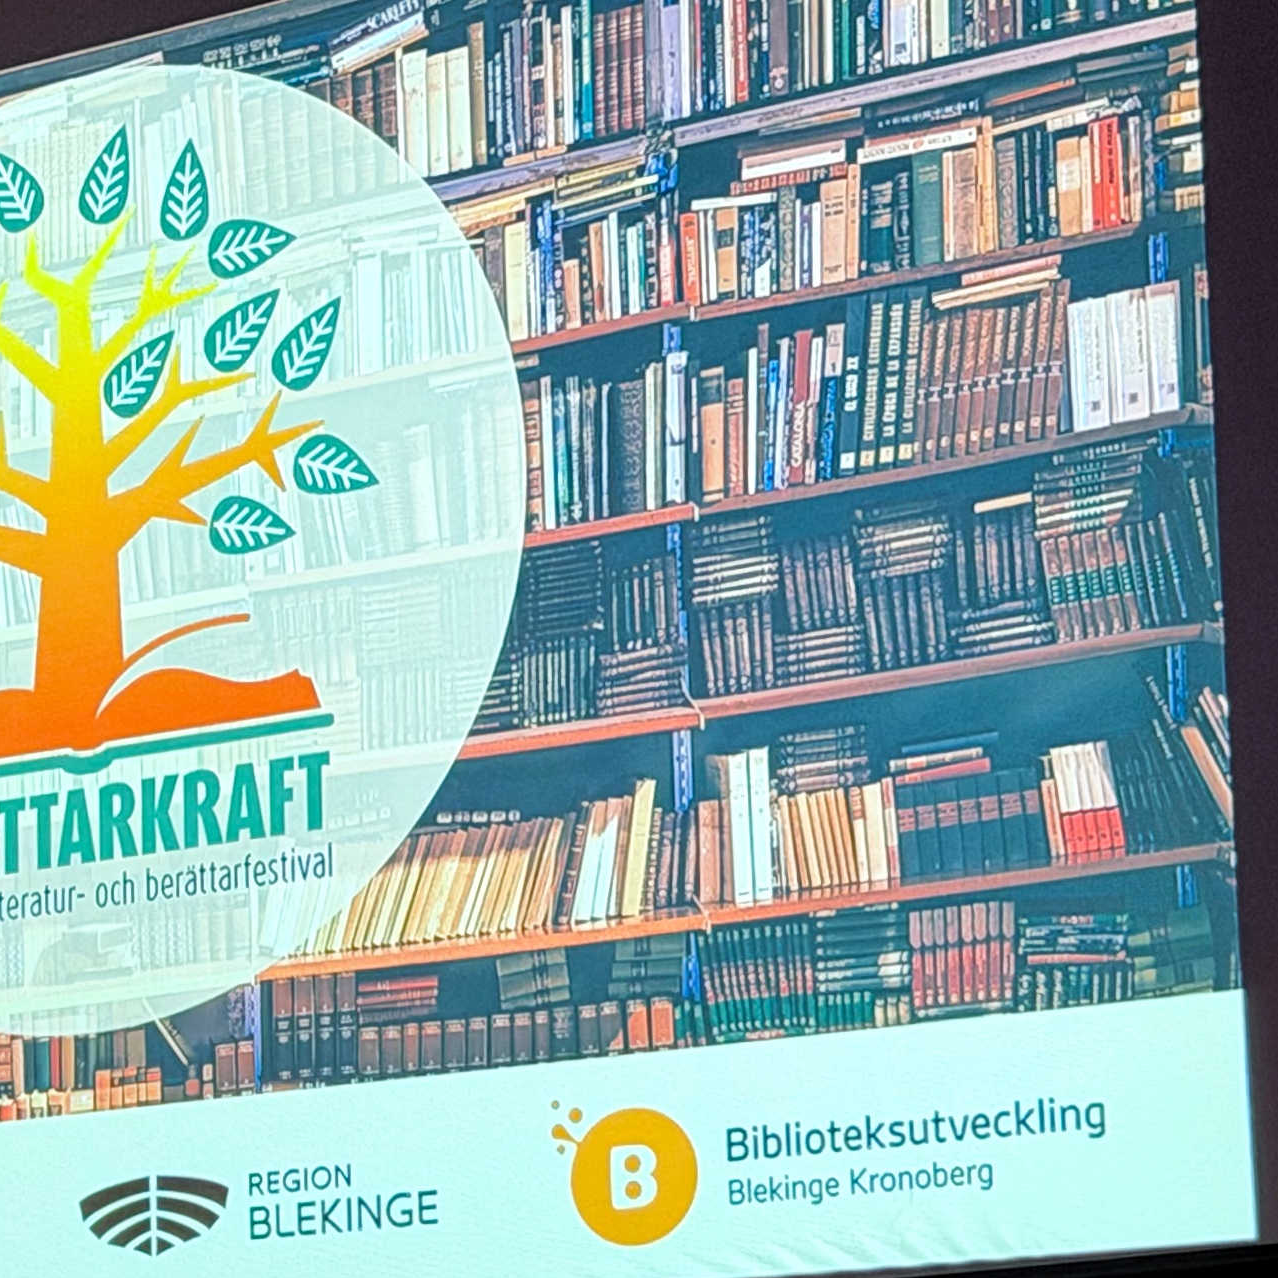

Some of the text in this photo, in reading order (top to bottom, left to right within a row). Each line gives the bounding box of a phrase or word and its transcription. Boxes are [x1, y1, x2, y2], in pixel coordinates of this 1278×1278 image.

[790, 400, 805, 467] CATALONIA
[96, 871, 134, 908] och
[146, 842, 332, 901] berättarfestival
[726, 1097, 1105, 1162] Biblioteksutveckling
[249, 1164, 351, 1196] REGION
[611, 1144, 659, 1210] B
[728, 1162, 993, 1205] Blekinge Kronoberg
[249, 1190, 438, 1240] BLEKINGE
